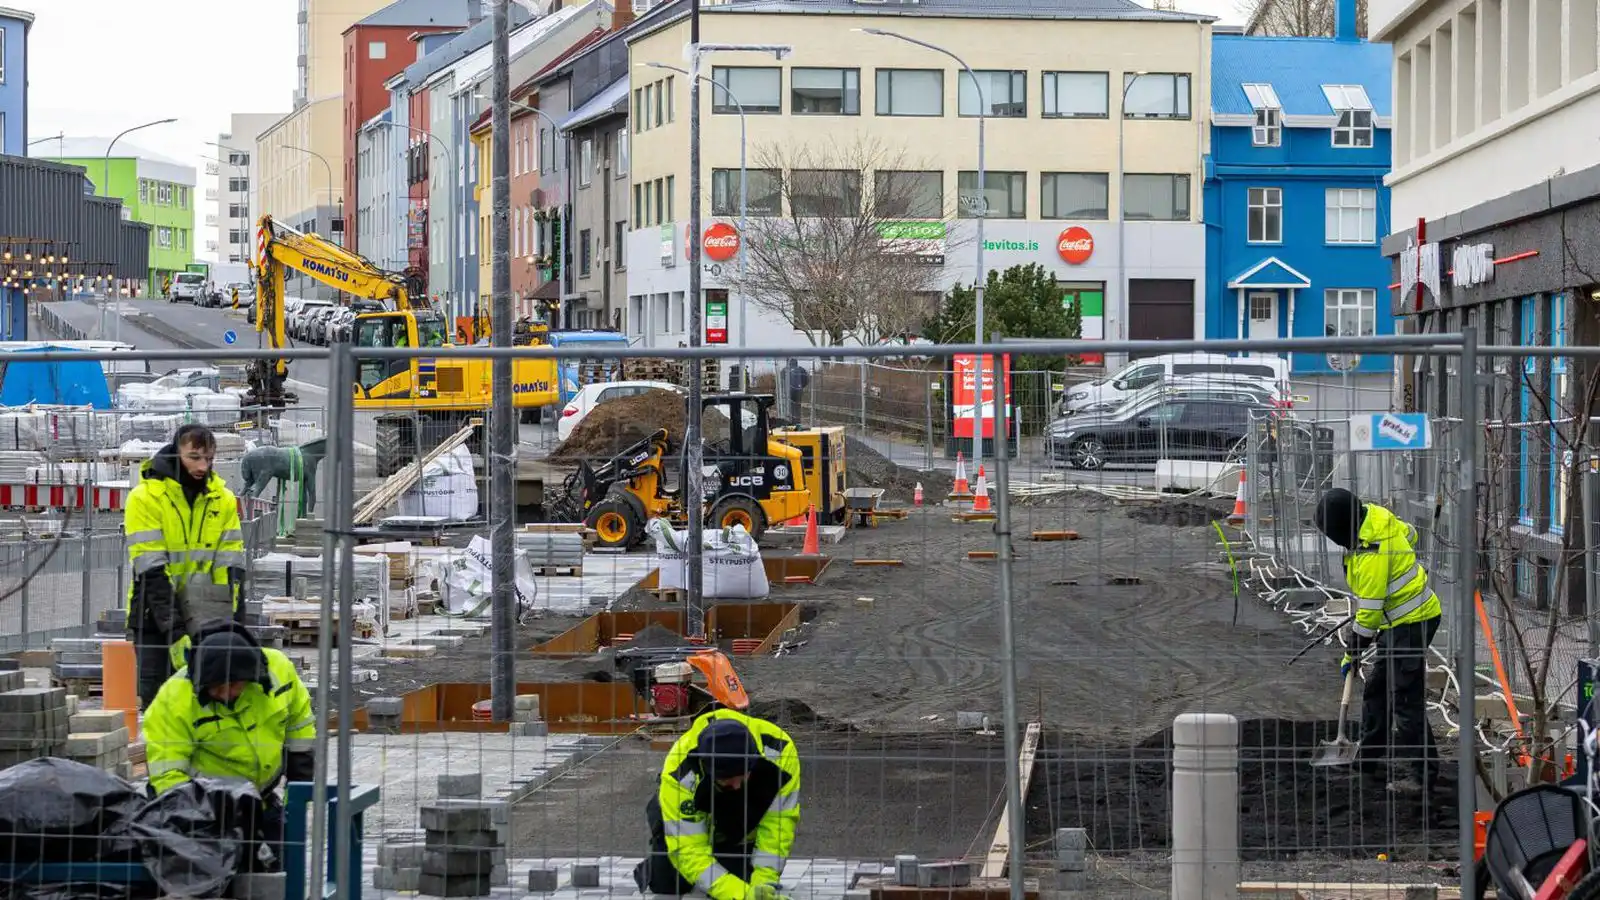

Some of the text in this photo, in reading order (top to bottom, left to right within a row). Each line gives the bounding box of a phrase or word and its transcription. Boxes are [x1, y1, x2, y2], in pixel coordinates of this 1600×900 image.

[704, 235, 737, 247] Coca-Cola
[983, 239, 1039, 250] devitos.is
[1059, 239, 1093, 251] Coca-Cola
[302, 258, 349, 282] KOMATSU
[512, 379, 549, 394] OMATSU
[629, 451, 649, 466] JCB
[776, 467, 786, 477] 30
[730, 475, 764, 487] JCB
